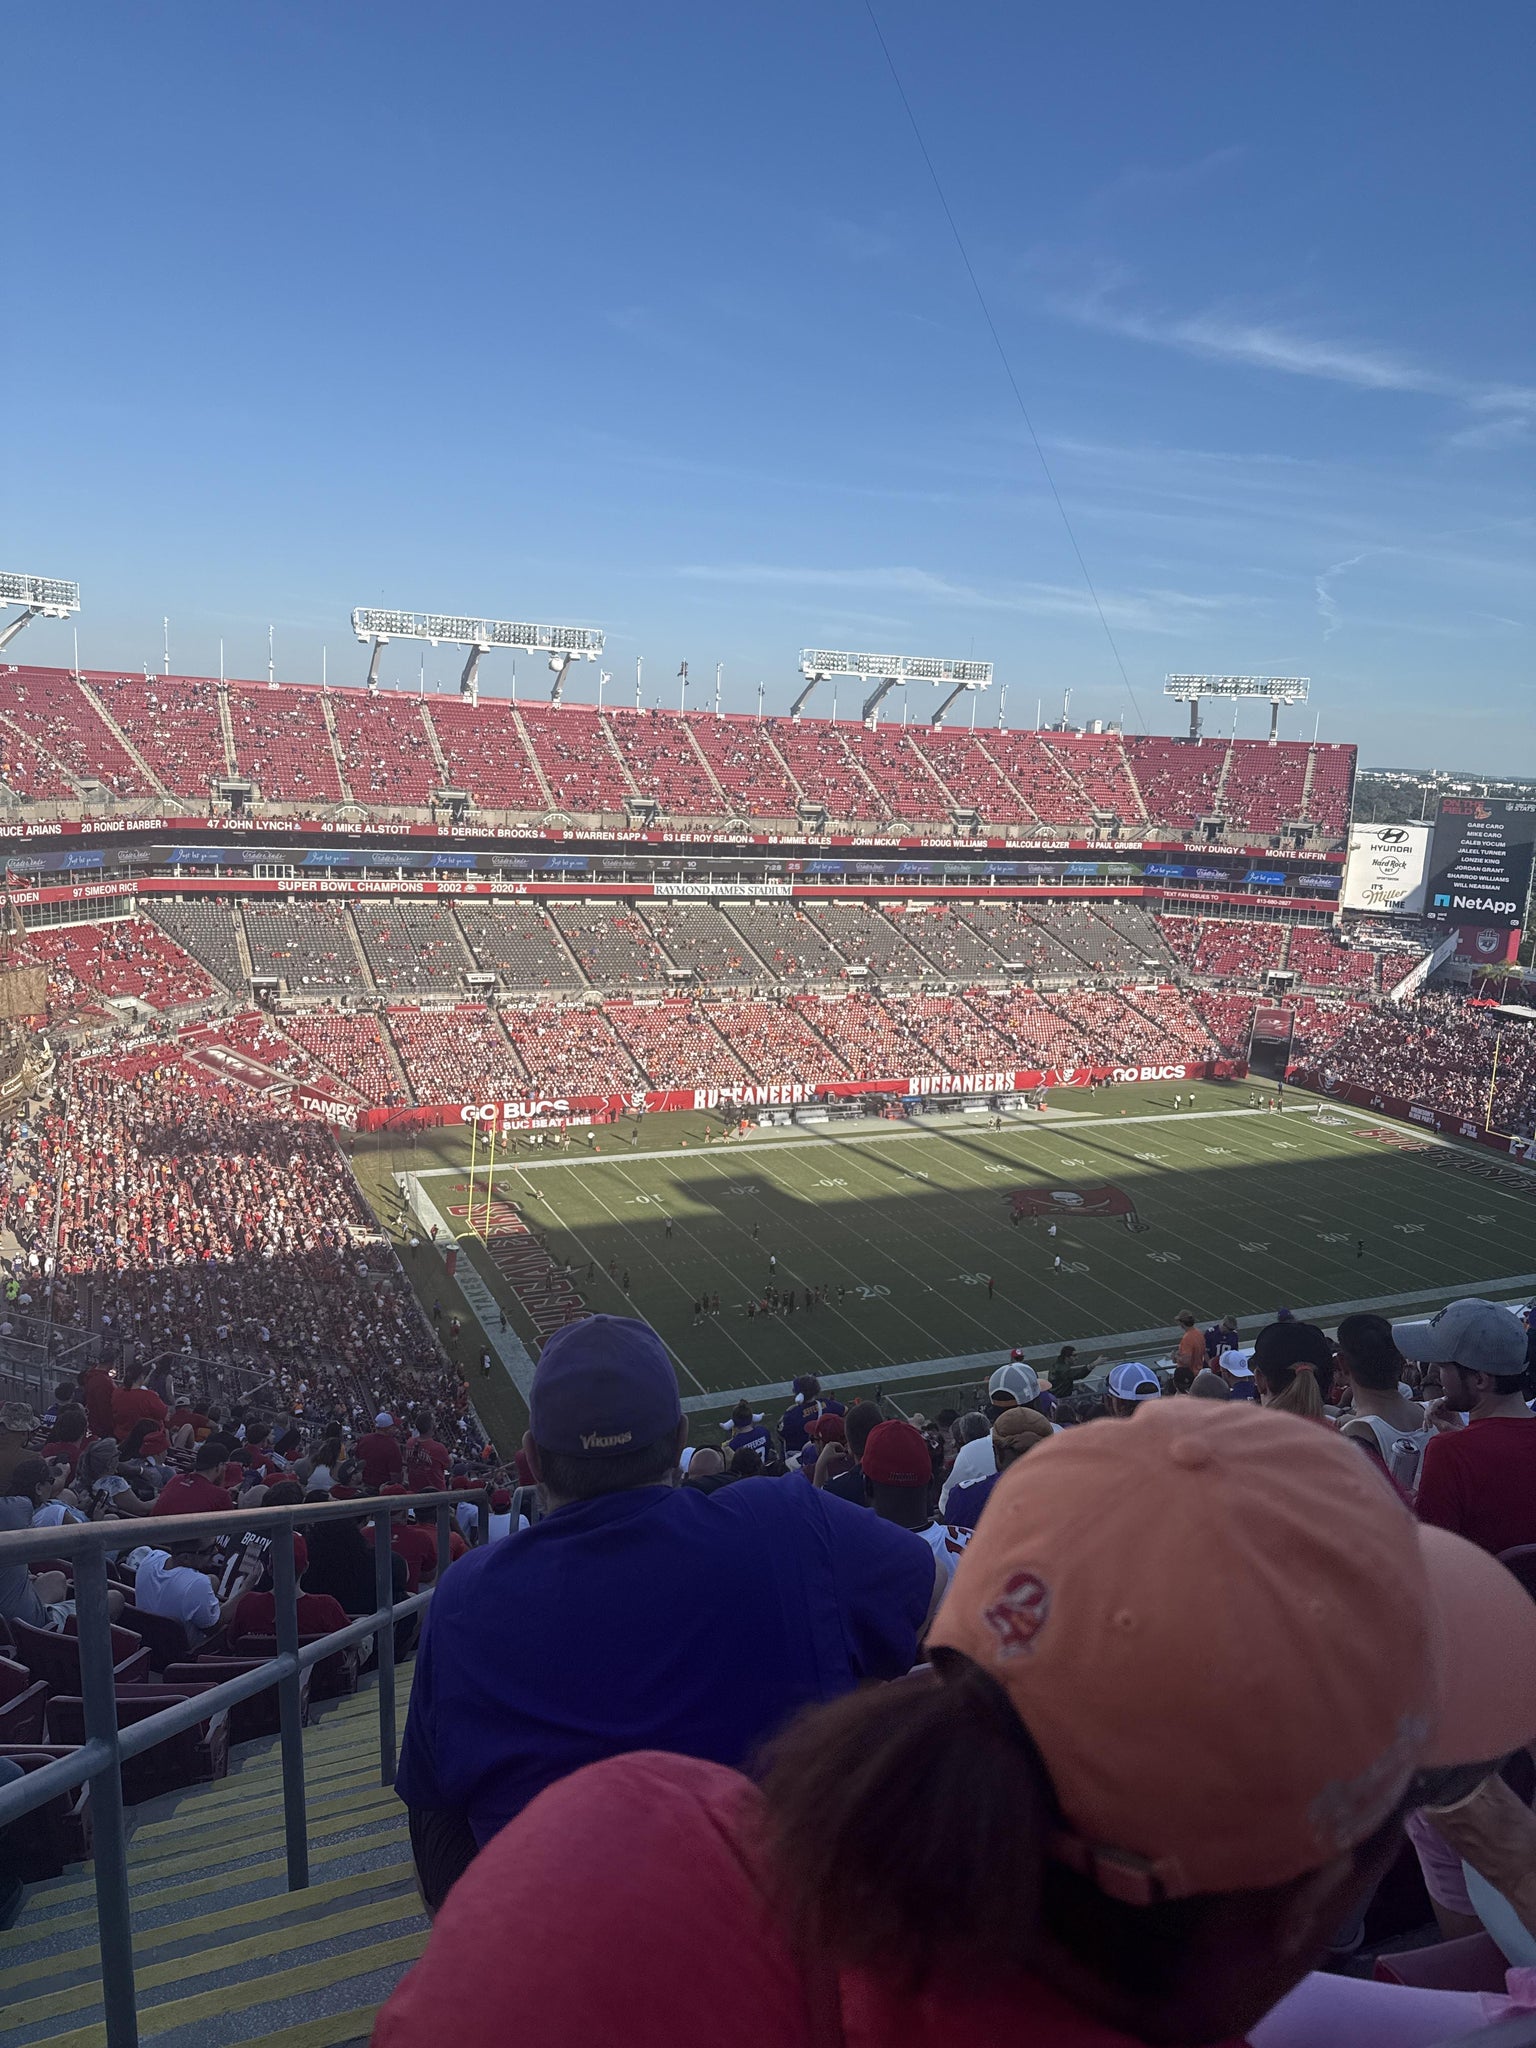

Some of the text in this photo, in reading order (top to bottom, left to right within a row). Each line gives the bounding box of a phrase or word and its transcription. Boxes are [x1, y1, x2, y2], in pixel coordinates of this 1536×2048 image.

[1443, 799, 1459, 807] ON
[1442, 806, 1473, 815] FIELD
[0, 824, 62, 837] RUCE ARIANS
[81, 819, 161, 833] 20 RONDÉ BARBER
[207, 820, 292, 830] 47 JOHN LYNCH
[321, 823, 411, 834] 40 MIKE ALSTOTT
[438, 827, 538, 838] 55 DERRICK BROOKS
[563, 831, 640, 840] 99 WARREN SAPP
[663, 833, 748, 843] 63 LEE ROY SELMON
[779, 836, 806, 844] JIMMIE
[808, 837, 831, 845] GILES
[874, 838, 901, 846] MCKAY
[920, 839, 928, 847] 12
[930, 839, 951, 847] DOUG
[1005, 840, 1040, 848] MALCOLM
[1184, 843, 1239, 854] TONY DUNGY
[1371, 844, 1412, 853] HYUNDAI
[1265, 849, 1327, 860] MONTE KIFFIN
[1372, 858, 1407, 869] Hard Rock
[1479, 875, 1510, 883] WILLIAMS
[73, 882, 138, 898] 97 SIMEON RICE
[278, 881, 514, 893] SUPER BOWL CHAMPIONS 2002 2020
[656, 885, 791, 895] RAYMOND JAMES STADIUM
[1190, 892, 1210, 900] ISSUES
[1361, 889, 1408, 906] Miller
[1384, 900, 1405, 909] TIME
[1453, 895, 1517, 914] NetApp
[140, 1034, 157, 1043] BUCS
[92, 1045, 110, 1055] BUCS
[1112, 1064, 1186, 1082] GO BUCS
[909, 1073, 1015, 1095] BUCCANEERS
[300, 1096, 357, 1118] TAMPA
[461, 1099, 570, 1121] GO BUCS
[503, 1116, 592, 1130] BUC BEAT LINE
[819, 1178, 848, 1187] 30
[730, 1185, 760, 1196] 20
[635, 1193, 664, 1204] 10
[1147, 1251, 1182, 1263] 50
[1060, 1261, 1090, 1274] 40
[446, 1200, 594, 1352] UCCANEERS
[959, 1272, 992, 1285] 30
[460, 1277, 494, 1311] TAKES
[855, 1284, 891, 1299] 20
[240, 1531, 272, 1552] BRADY
